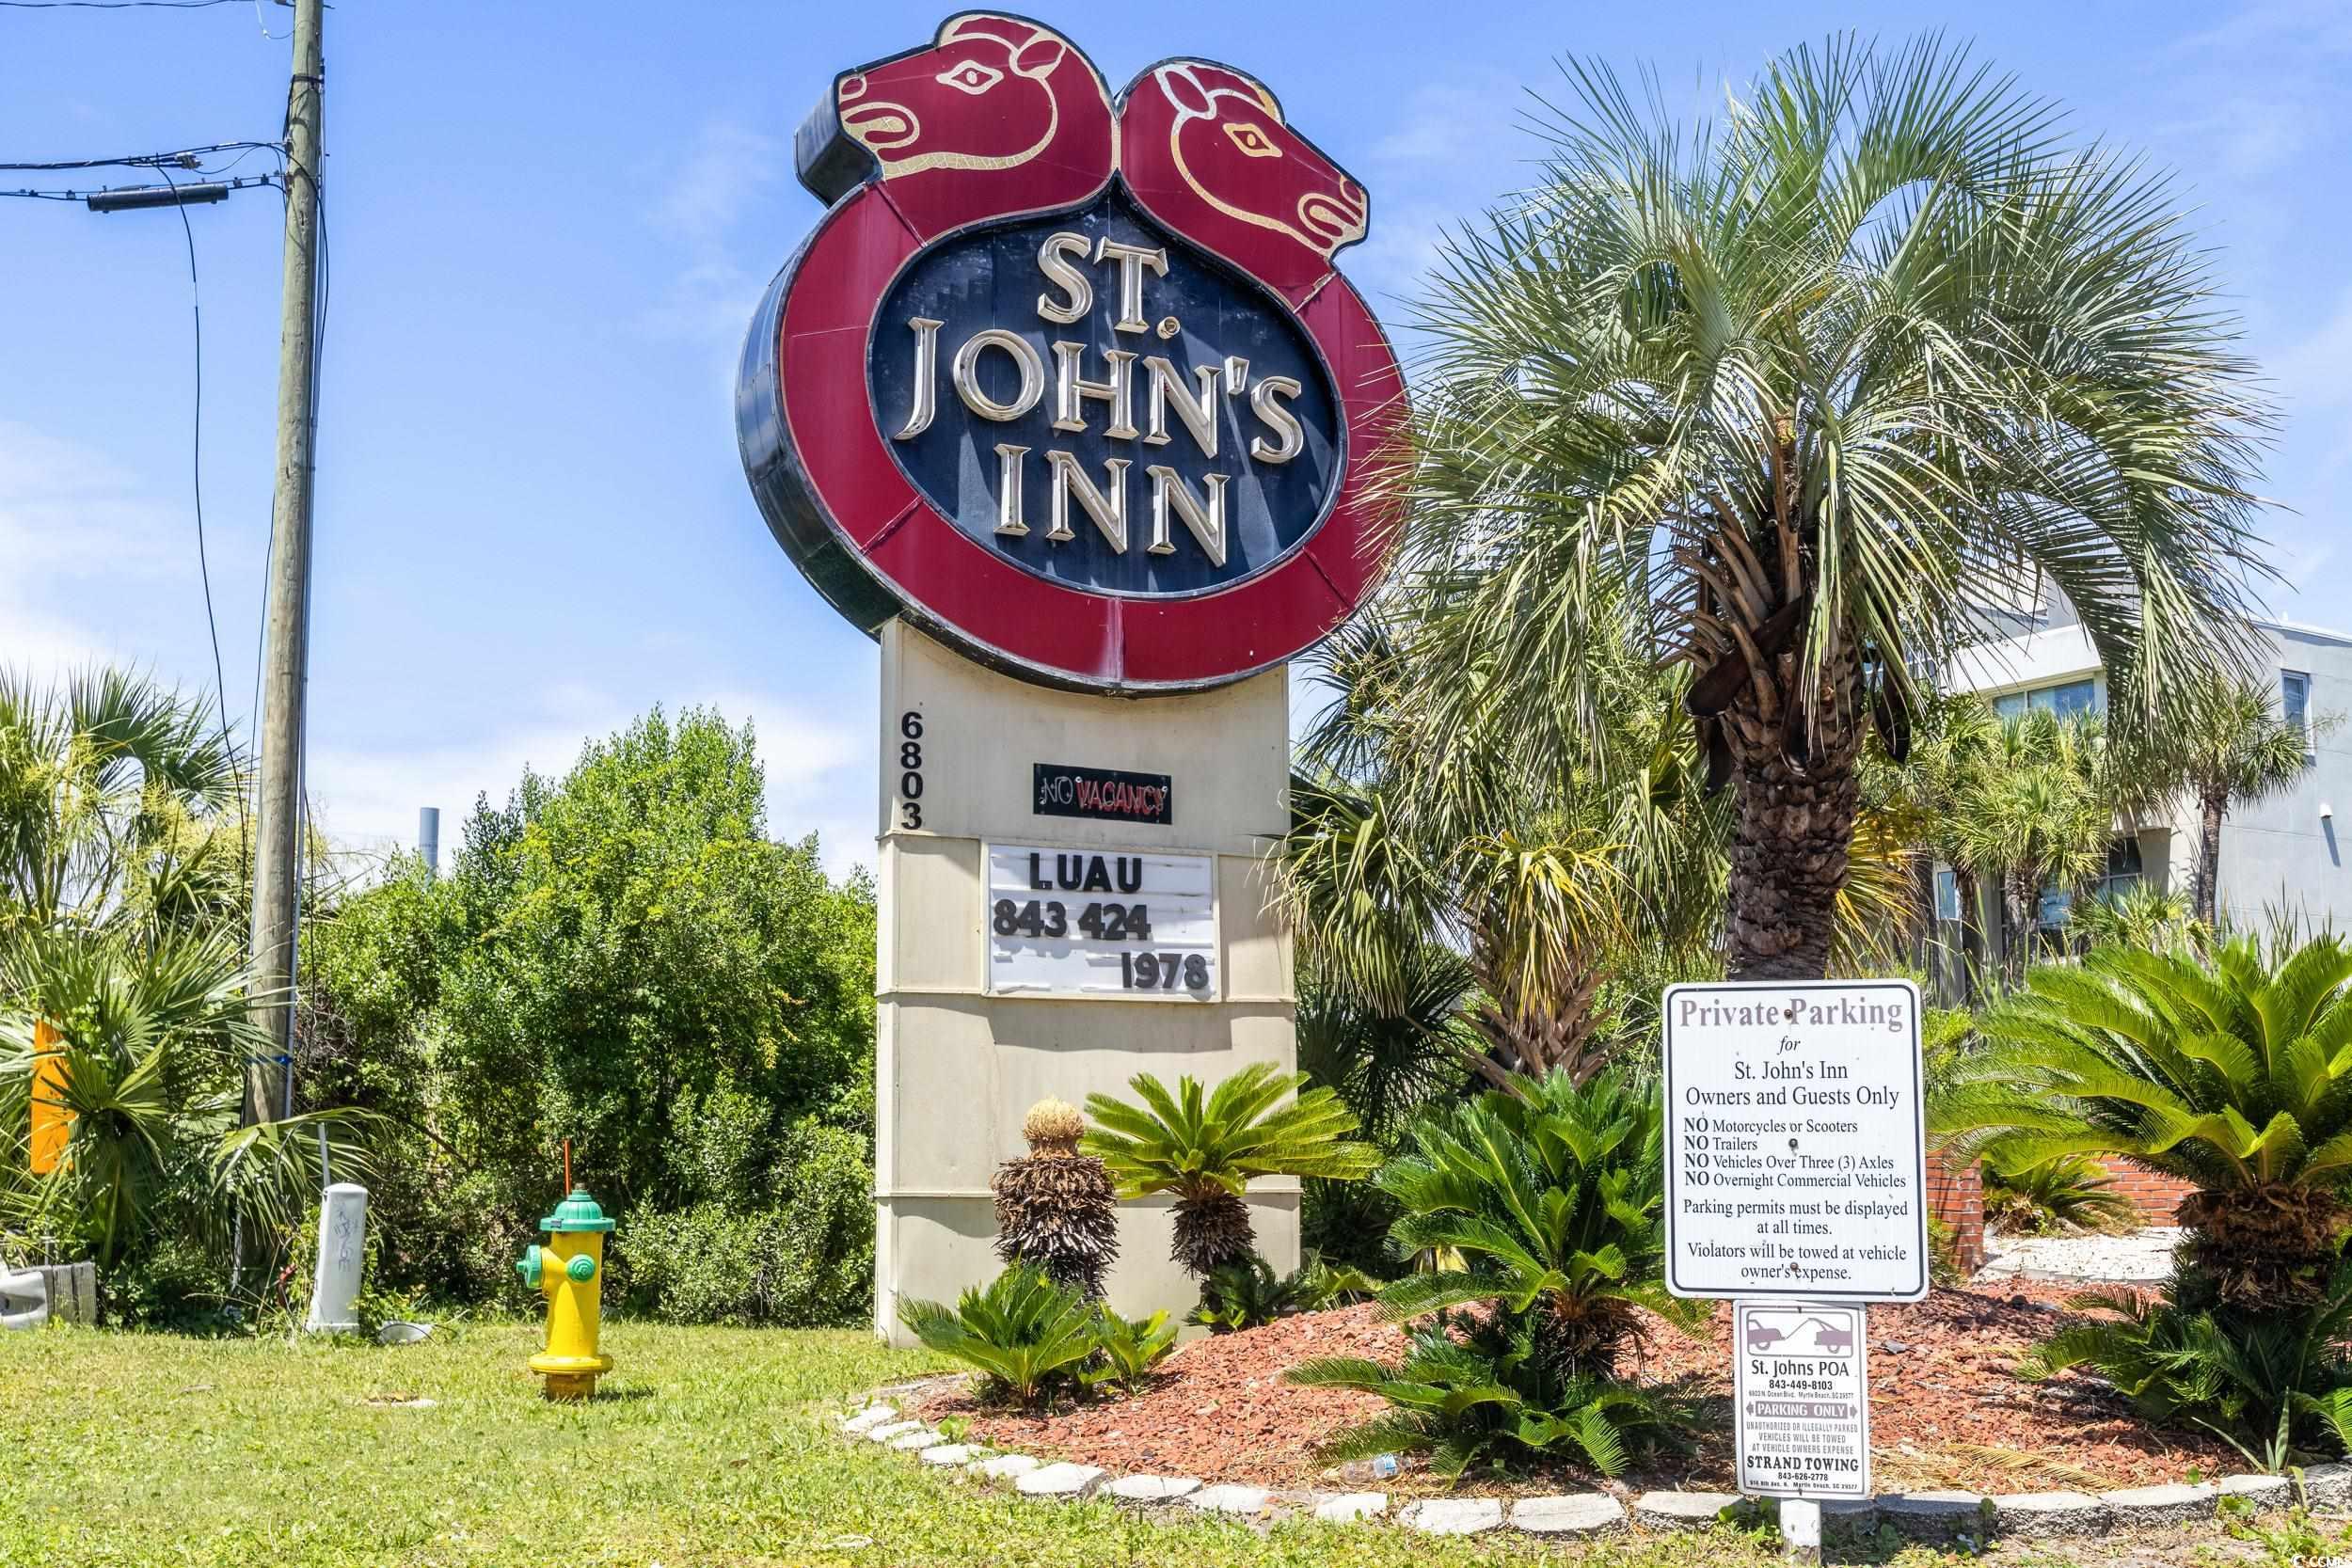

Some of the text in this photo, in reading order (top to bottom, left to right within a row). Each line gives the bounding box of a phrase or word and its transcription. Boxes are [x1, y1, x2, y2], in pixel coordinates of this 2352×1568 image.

[1037, 231, 1181, 340] ST.
[894, 317, 1305, 464] JOHN'S
[993, 444, 1230, 568] INN
[900, 711, 923, 830] 6803
[1039, 776, 1168, 816] NO VACANCY
[1030, 852, 1142, 893] LUAU
[993, 898, 1152, 941] 843 424
[1121, 952, 1209, 989] 1978
[1679, 997, 1903, 1032] Private Parking
[1776, 1035, 1801, 1055] for
[1734, 1060, 1848, 1080] St. John's Inn
[1686, 1085, 1899, 1110] Owners and Guests Only
[1684, 1117, 1858, 1135] NO Motorcycles or Scooters
[1684, 1135, 1757, 1150] NO Trailers
[1684, 1153, 1894, 1171] NO Vehicles Over Three (3) Axles
[1685, 1171, 1906, 1190] NO Overnight Commercial Vehicles
[1683, 1199, 1908, 1219] Parking permits must be displayed
[1756, 1220, 1833, 1235] at all times.
[1688, 1241, 1907, 1260] Violators will be towed at vehicle
[1740, 1264, 1851, 1282] owner's expense.
[1752, 1359, 1850, 1378] St. Johns POA
[1769, 1380, 1833, 1390] 843-449-8103
[1756, 1402, 1846, 1418] PARKING ONLY
[1746, 1421, 1858, 1433] UNAUTHORIZED OR ILLEGALLY PARKED
[1758, 1433, 1846, 1443] VEHICLES WILL BE TOWED
[1752, 1443, 1853, 1454] AT VEHICLE OWNERS EXPENSE
[1747, 1455, 1859, 1472] STRAND TOWING
[1777, 1472, 1829, 1481] 843-626-2778
